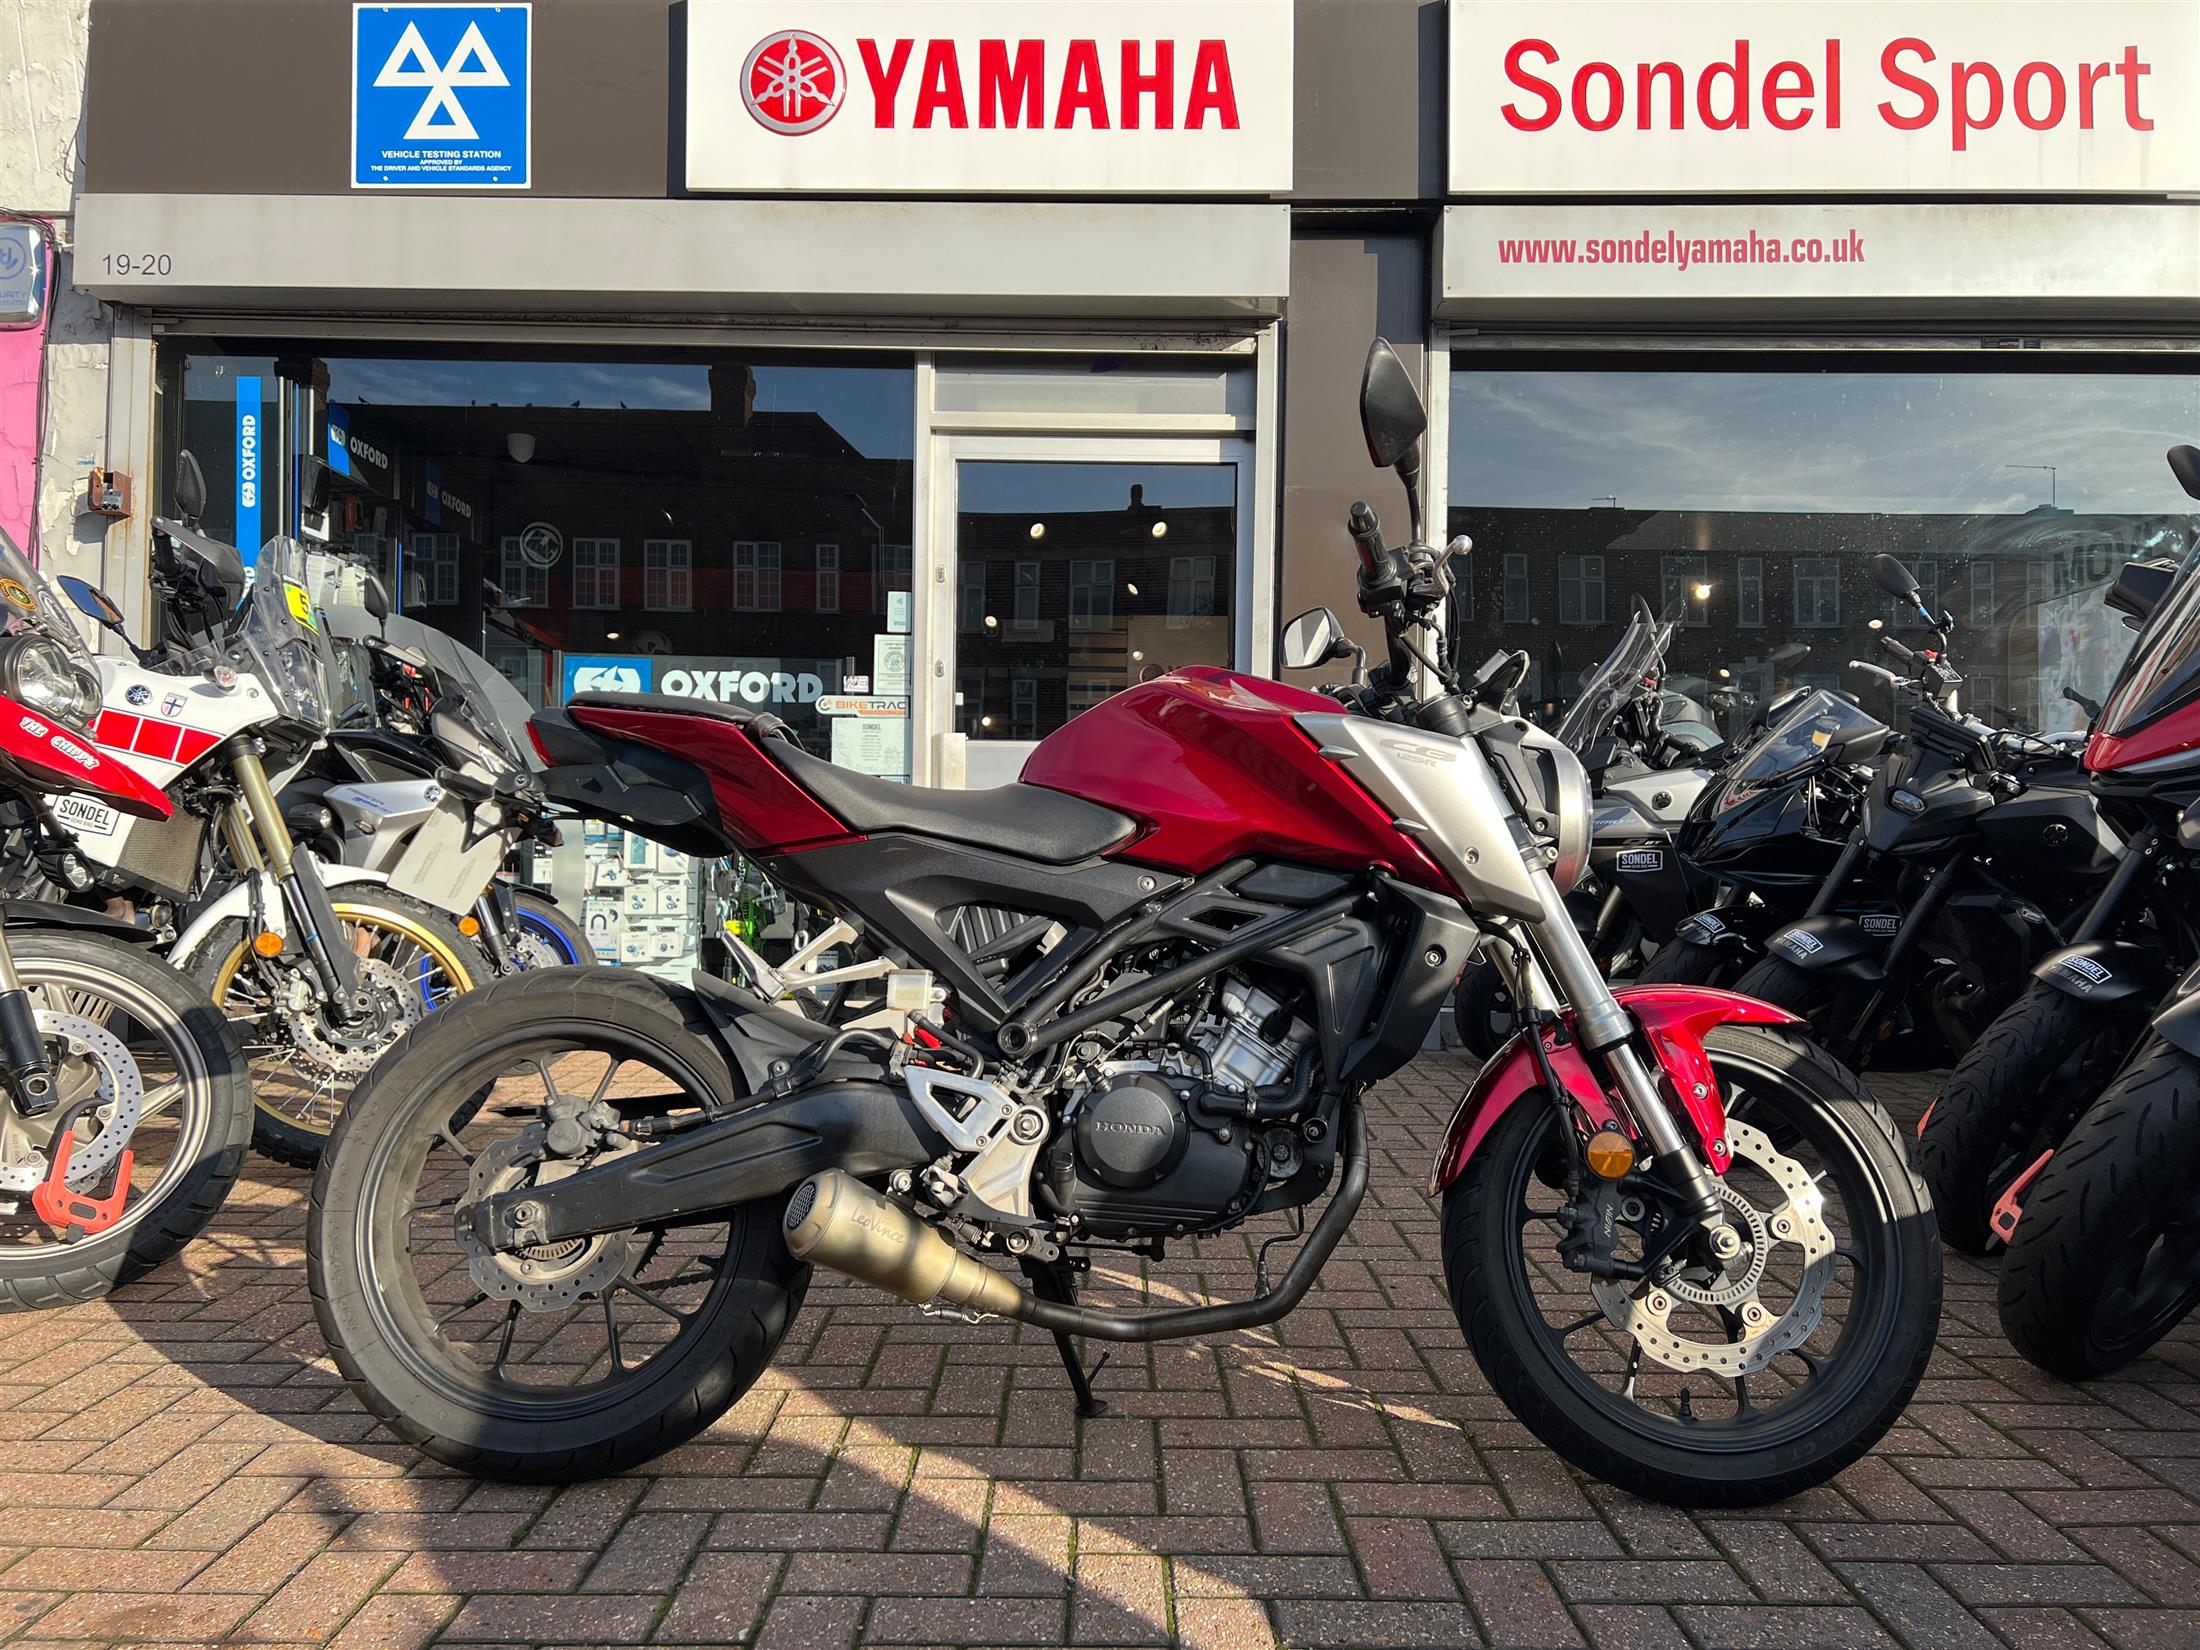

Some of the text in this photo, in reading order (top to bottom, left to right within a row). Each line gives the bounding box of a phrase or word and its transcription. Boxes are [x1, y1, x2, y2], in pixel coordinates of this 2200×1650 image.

[856, 38, 1240, 130] YAMAHA
[1500, 36, 2155, 152] Sondel Sport
[381, 150, 501, 158] VEHICLE TESTING STATION
[1498, 228, 1867, 272] www.sondelyamaha.co.uk
[102, 254, 172, 276] 19-20
[243, 414, 256, 480] OXFORD
[350, 435, 388, 470] OXFORD
[441, 490, 471, 519] OXFORD
[660, 669, 824, 703] OXFORD
[836, 700, 907, 710] BIKETRAC
[60, 798, 110, 826] SONDEL
[1621, 853, 1659, 865] SONDEL
[1863, 917, 1897, 929] SONDEL
[1791, 930, 1817, 948] SONDEL
[2047, 964, 2093, 994] YAMAHA
[2069, 956, 2104, 979] SONDEL
[1095, 1120, 1167, 1136] HONDA
[851, 1203, 904, 1244] LeoVince
